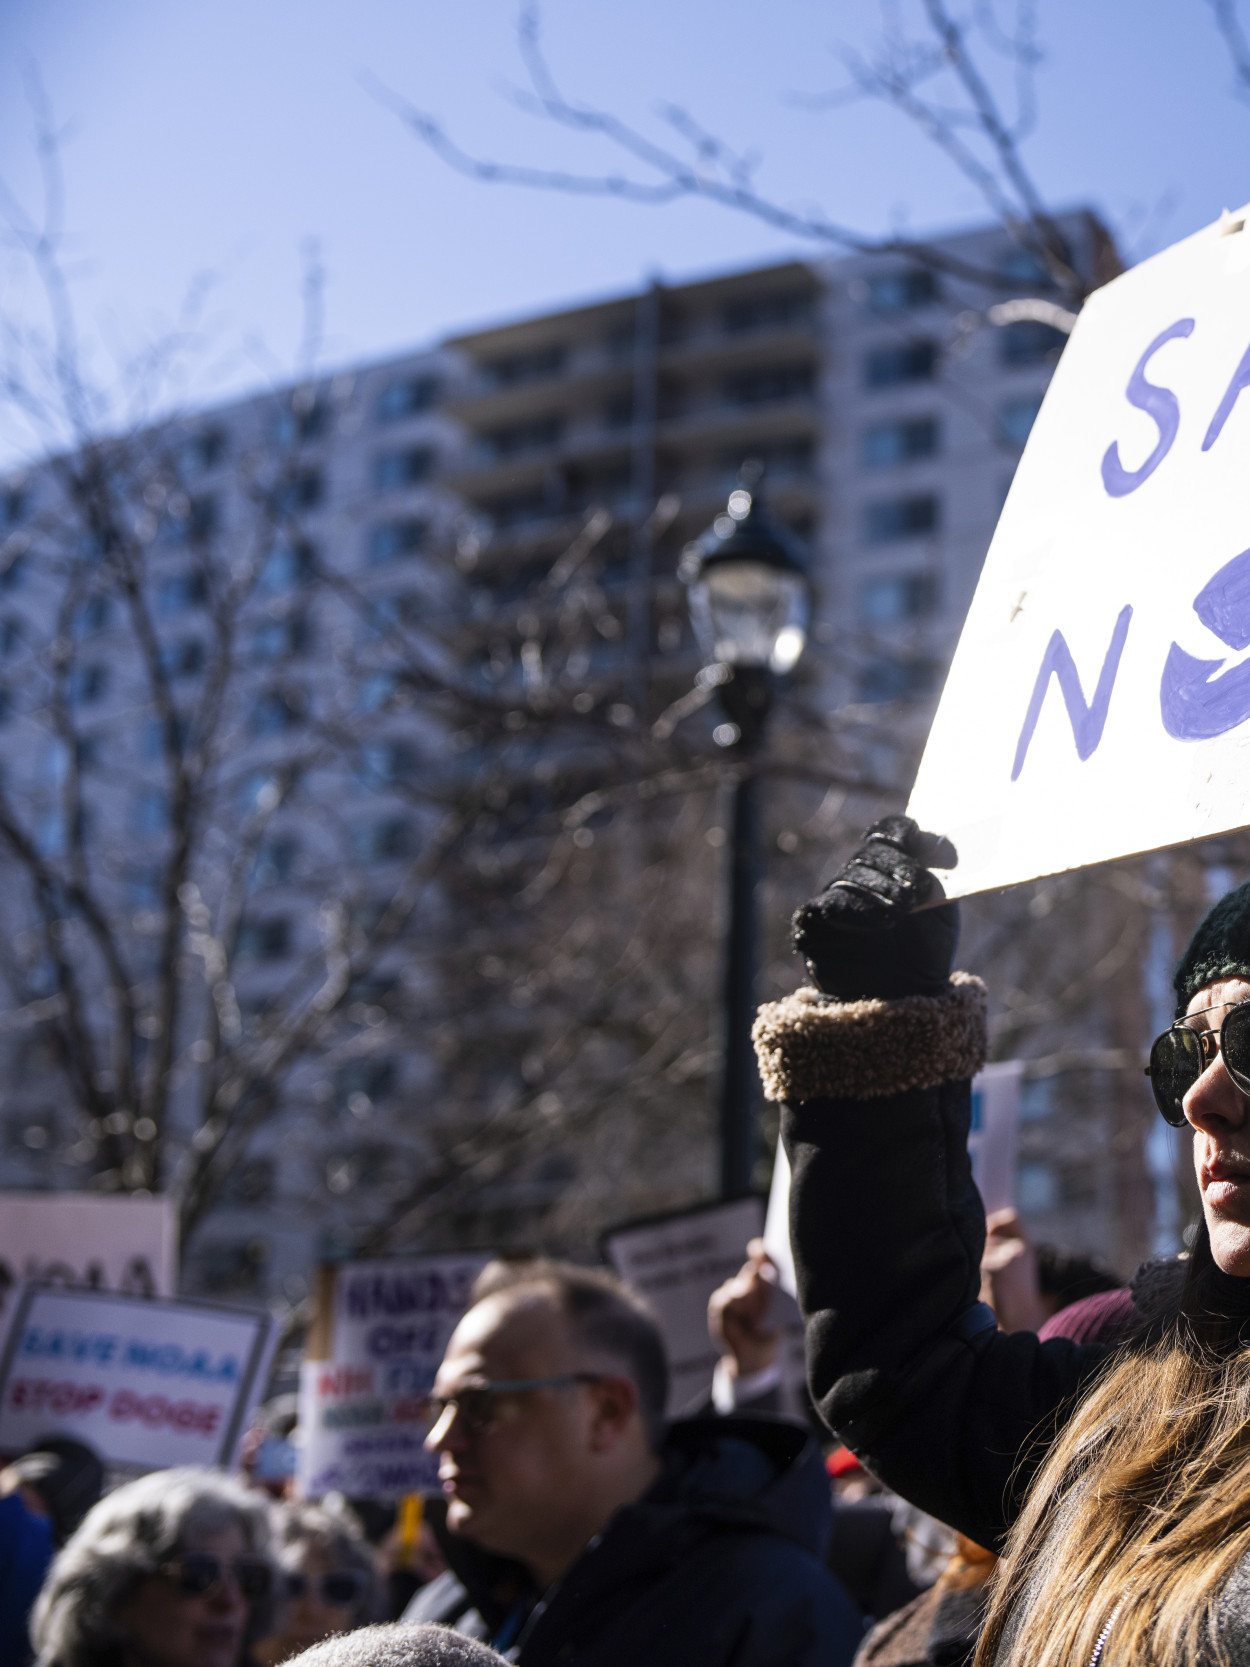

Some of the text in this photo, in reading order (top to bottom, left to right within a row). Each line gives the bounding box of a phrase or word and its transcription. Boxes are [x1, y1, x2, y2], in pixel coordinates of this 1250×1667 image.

[22, 1328, 239, 1383] SAVE NOAA
[10, 1377, 222, 1438] STOP DOGE
